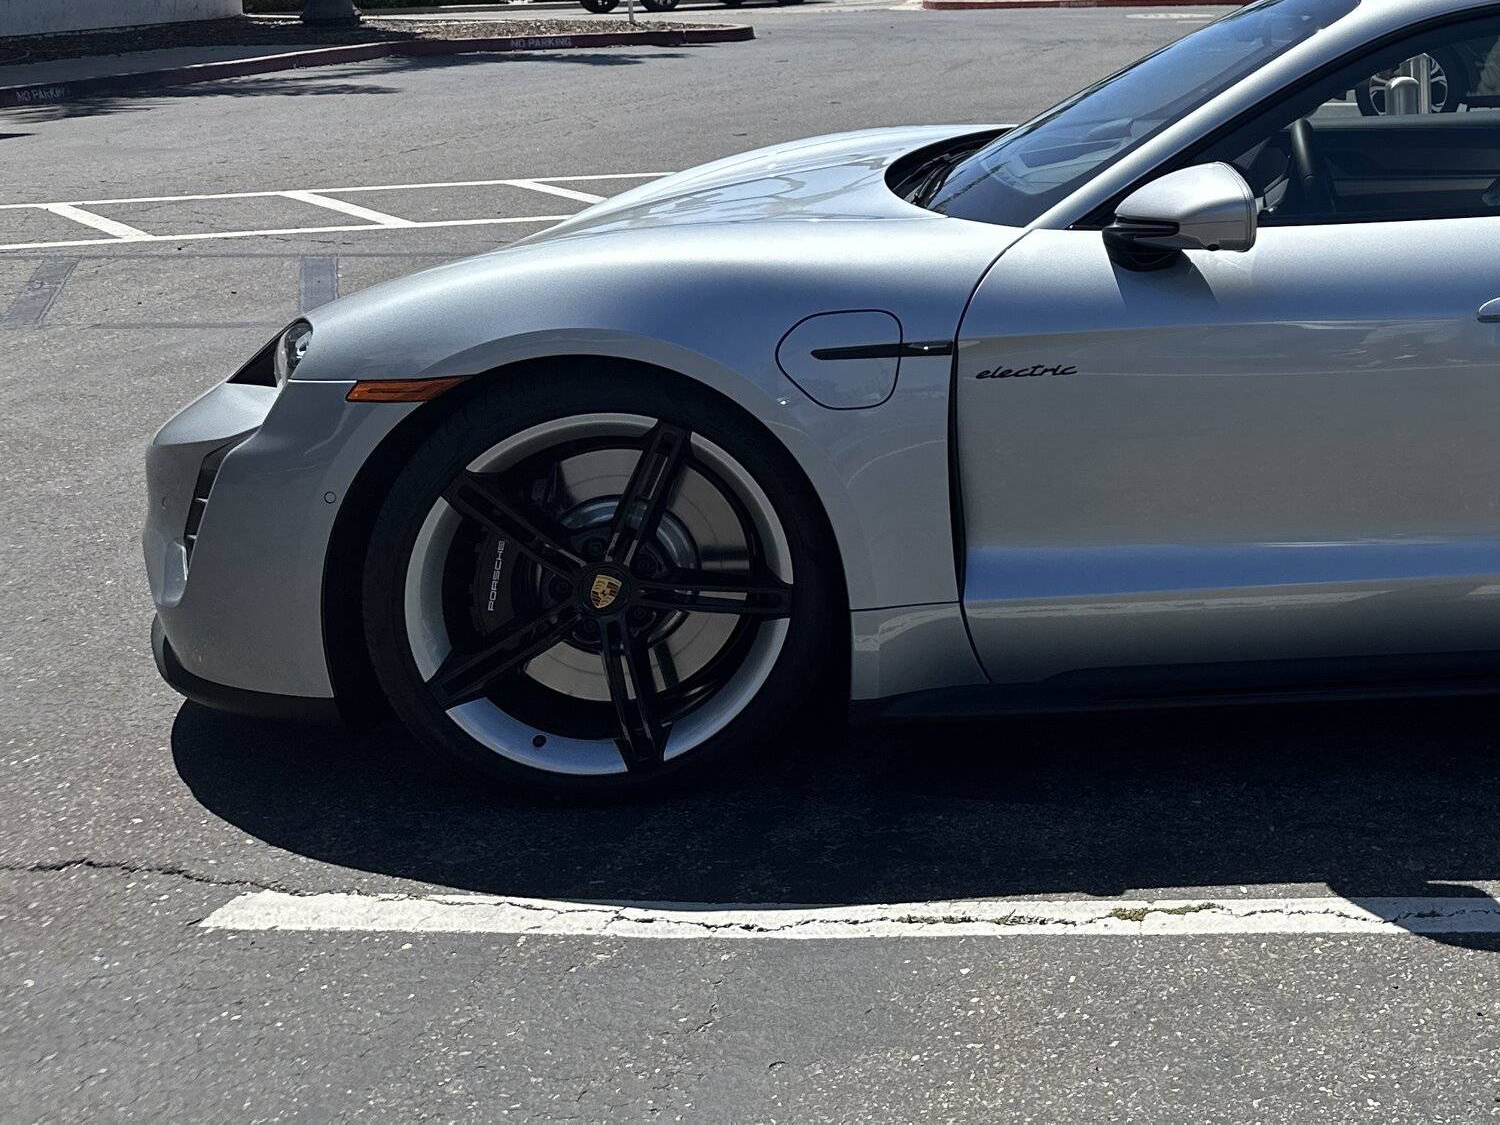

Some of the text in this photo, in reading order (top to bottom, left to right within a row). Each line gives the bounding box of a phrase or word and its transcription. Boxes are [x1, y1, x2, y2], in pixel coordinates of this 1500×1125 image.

[510, 38, 526, 48] NO
[976, 364, 1078, 379] electric
[488, 540, 505, 611] PORSCHE
